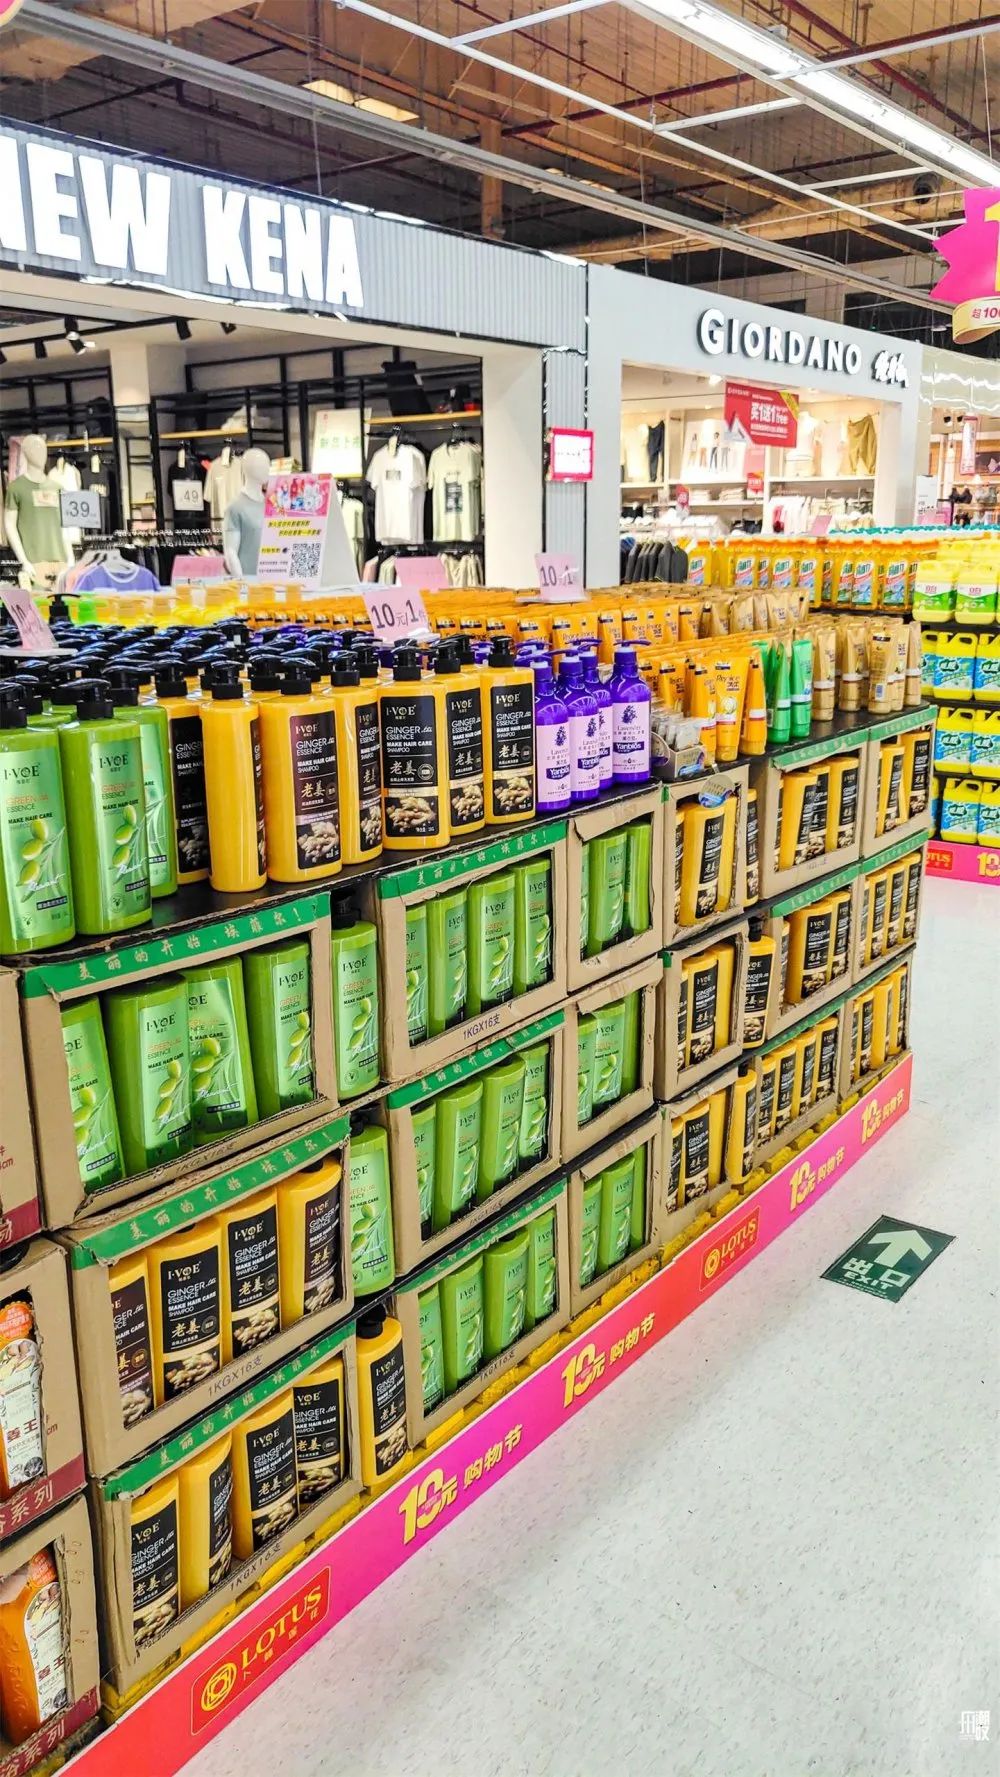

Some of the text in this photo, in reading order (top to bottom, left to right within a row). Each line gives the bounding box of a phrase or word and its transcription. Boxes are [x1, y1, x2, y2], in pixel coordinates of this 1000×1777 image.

[203, 185, 364, 307] KENA
[699, 308, 862, 375] GIORDANO
[69, 501, 90, 517] 39
[452, 718, 476, 727] GINGER
[496, 712, 523, 721] GINGER
[386, 726, 420, 734] GINGER
[296, 738, 327, 749] GINGER
[297, 747, 322, 756] ESSENCE
[499, 743, 520, 758] 老姜
[455, 750, 475, 766] 老姜
[390, 760, 417, 775] 老姜
[301, 780, 325, 797] 老姜
[8, 816, 24, 824] MAKE
[463, 1013, 500, 1041] 1KGX16支
[86, 1078, 98, 1087] CARE
[721, 1218, 755, 1258] LOTUS
[235, 1239, 267, 1258] GINGER
[235, 1250, 262, 1264] ESSENCE
[842, 1257, 911, 1287] 出口
[239, 1276, 264, 1297] 老姜
[844, 1271, 893, 1290] EXIT
[167, 1282, 205, 1298] GINGER
[168, 1291, 199, 1305] ESSENCE
[168, 1291, 217, 1312] MAKE HAIR CARE
[131, 1321, 145, 1332] CARE
[172, 1317, 201, 1338] 老姜
[609, 1313, 655, 1366] 购物节
[208, 1354, 264, 1398] 1KGX16支
[323, 1417, 336, 1425] CARE
[254, 1442, 284, 1462] GINGER
[296, 1437, 321, 1452] 老姜
[463, 1424, 523, 1490] 购物节
[258, 1475, 281, 1497] 老姜
[161, 1543, 175, 1556] CARE
[133, 1574, 160, 1598] 老姜
[241, 1593, 322, 1670] LOTUS
